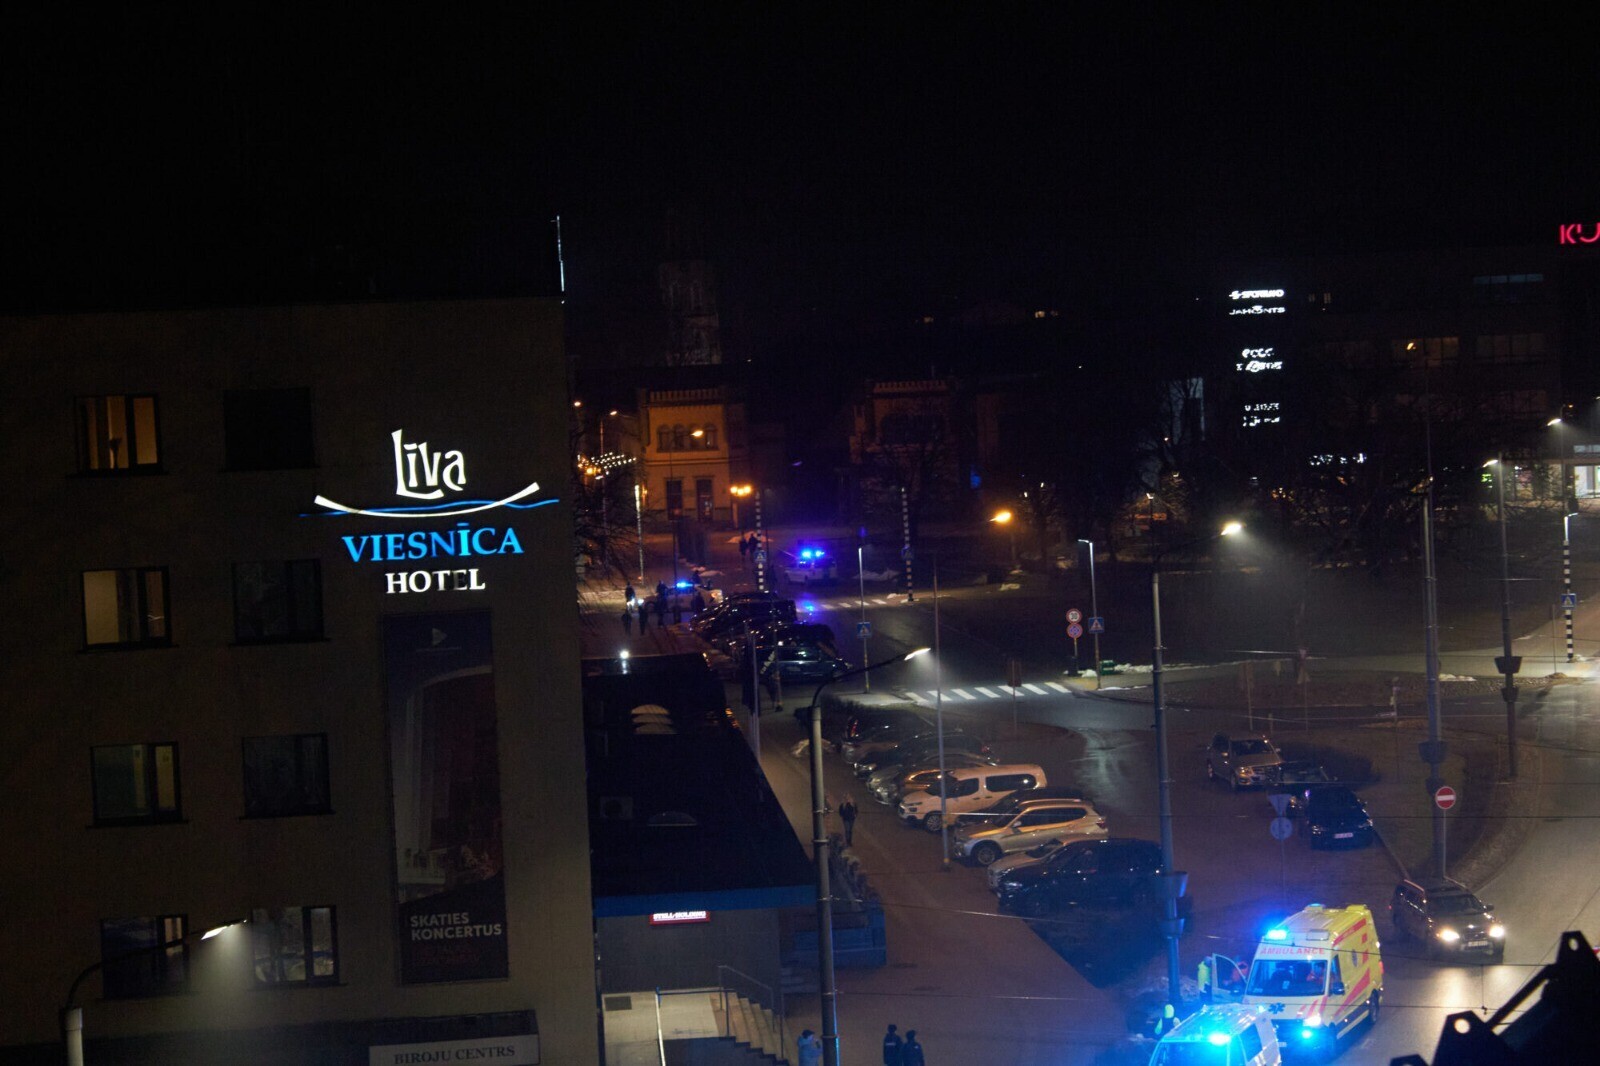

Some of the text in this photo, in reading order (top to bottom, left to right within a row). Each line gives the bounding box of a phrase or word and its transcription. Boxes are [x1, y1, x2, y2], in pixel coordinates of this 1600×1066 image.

[391, 429, 466, 499] Līva
[341, 522, 525, 562] VIESNĪCA
[385, 568, 486, 594] HOTEL
[410, 912, 470, 928] SKATIES
[411, 923, 503, 941] KONCERTUS
[1260, 947, 1325, 955] AMBULANCE
[394, 1045, 516, 1065] BIROJU CENTRS
